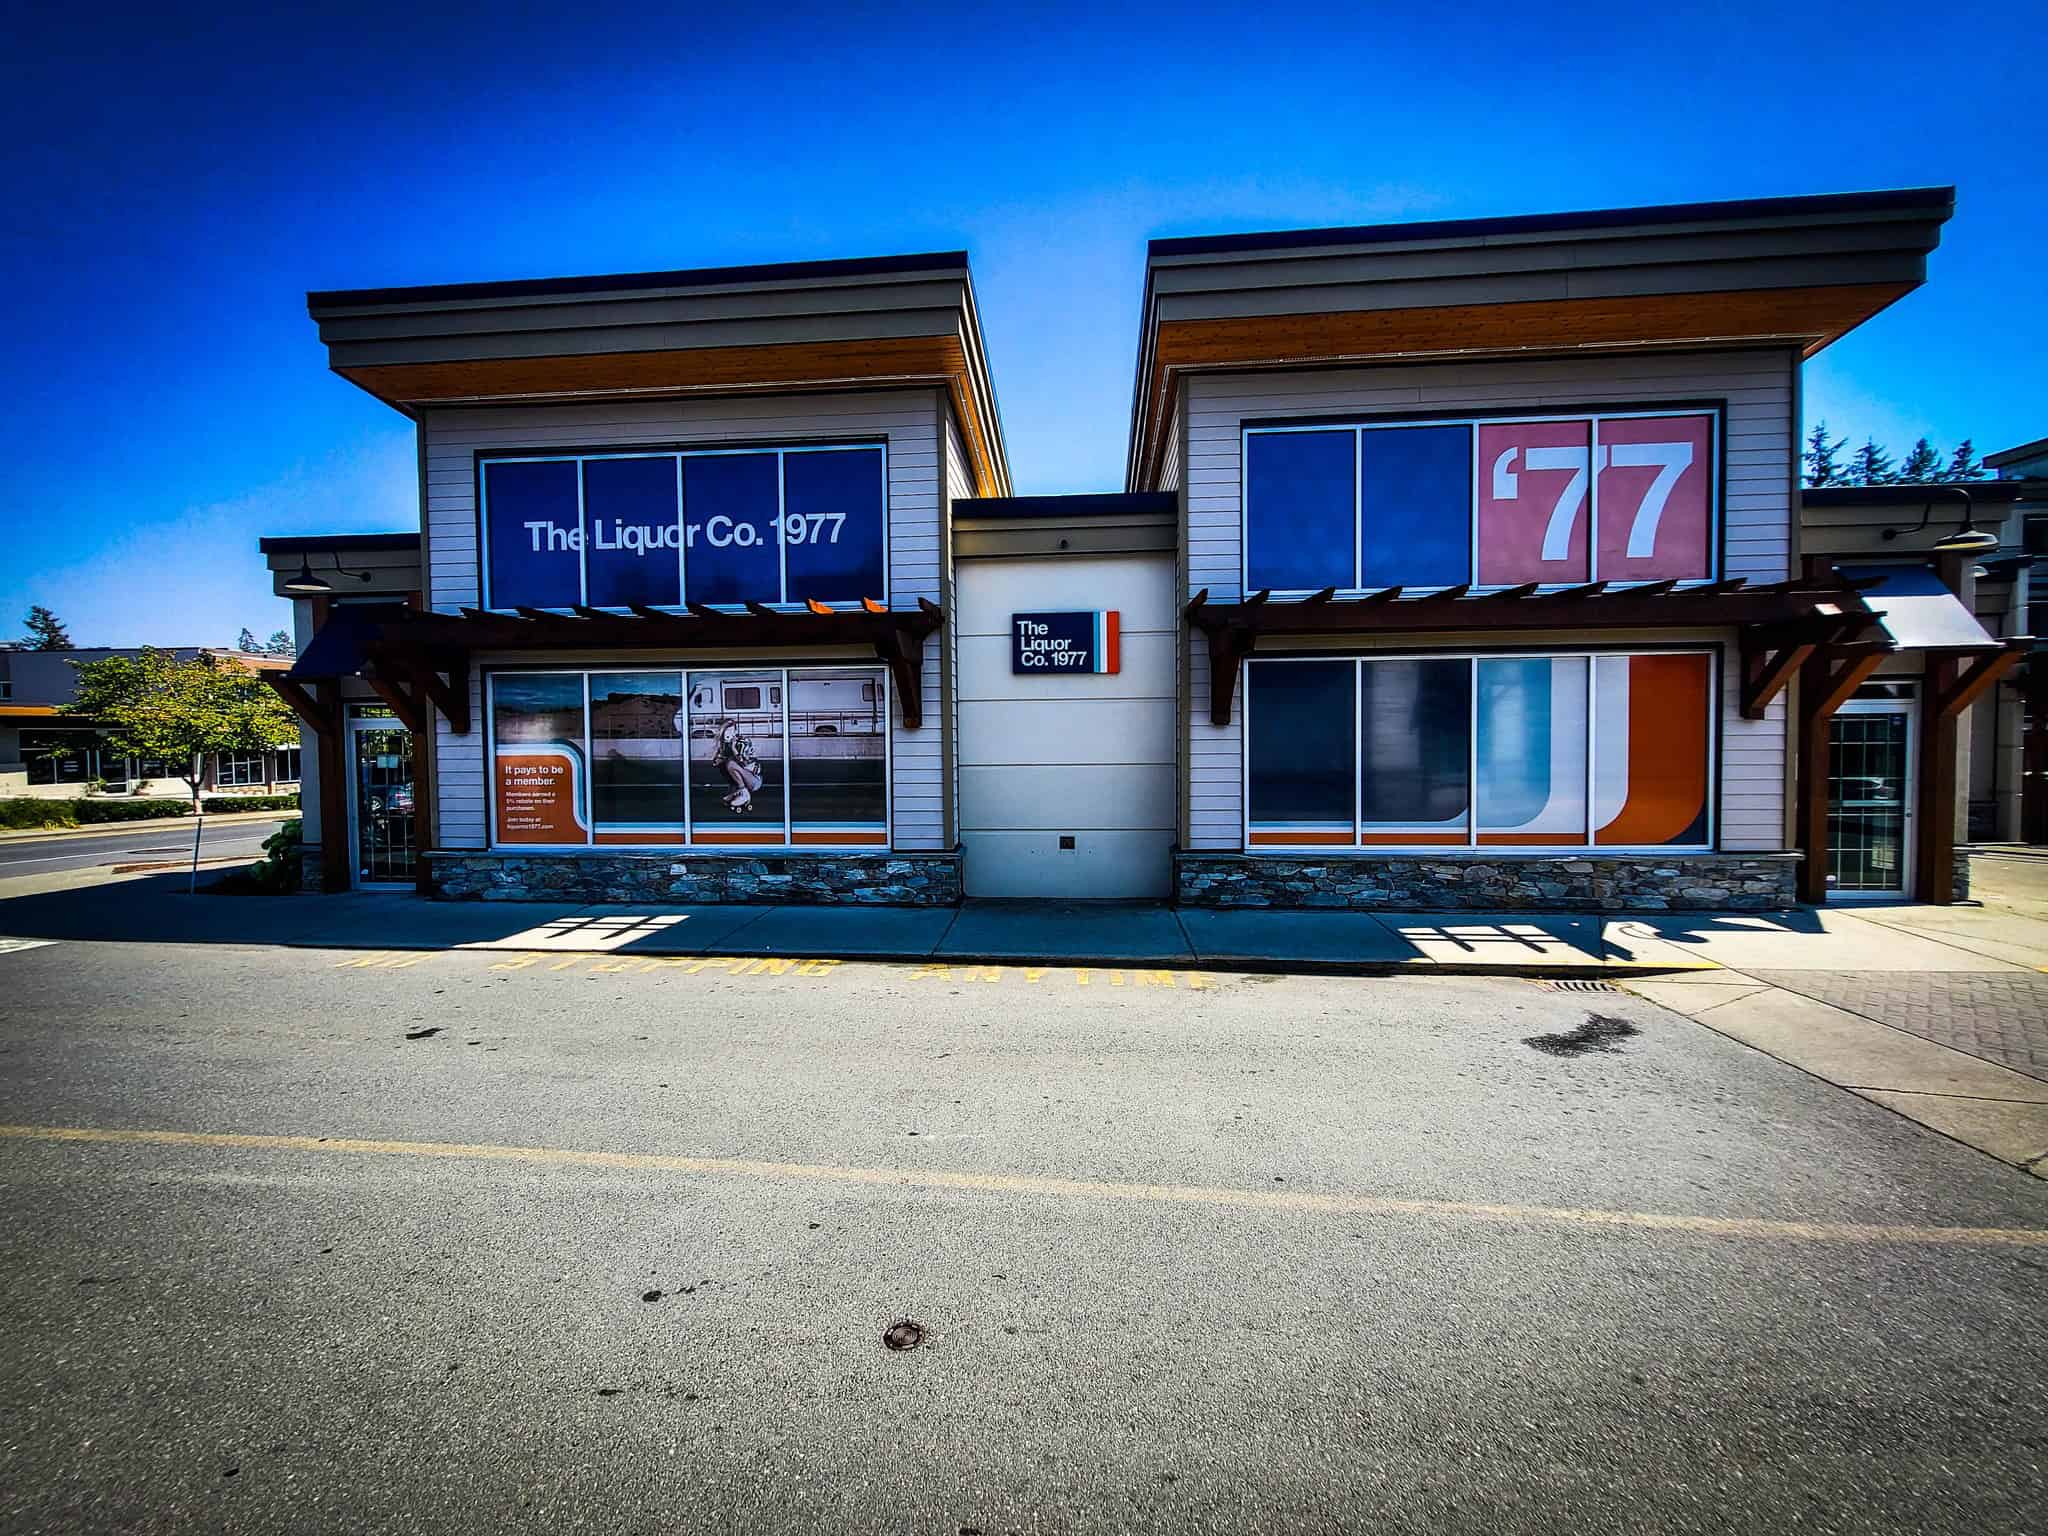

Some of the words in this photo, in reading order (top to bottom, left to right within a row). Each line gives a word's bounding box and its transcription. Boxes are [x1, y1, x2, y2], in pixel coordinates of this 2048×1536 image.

[524, 521, 588, 551] The
[595, 518, 700, 556] Liquor
[706, 515, 763, 547] Co.
[769, 512, 847, 545] 1977
[1016, 620, 1048, 636] The
[1021, 636, 1071, 654] Liquor
[1021, 651, 1049, 666] Co.
[1051, 651, 1087, 666] 1977
[505, 765, 512, 774] It
[514, 766, 537, 777] pays
[539, 765, 549, 774] to
[551, 765, 564, 774] be
[505, 778, 512, 786] a
[514, 776, 556, 786] member.
